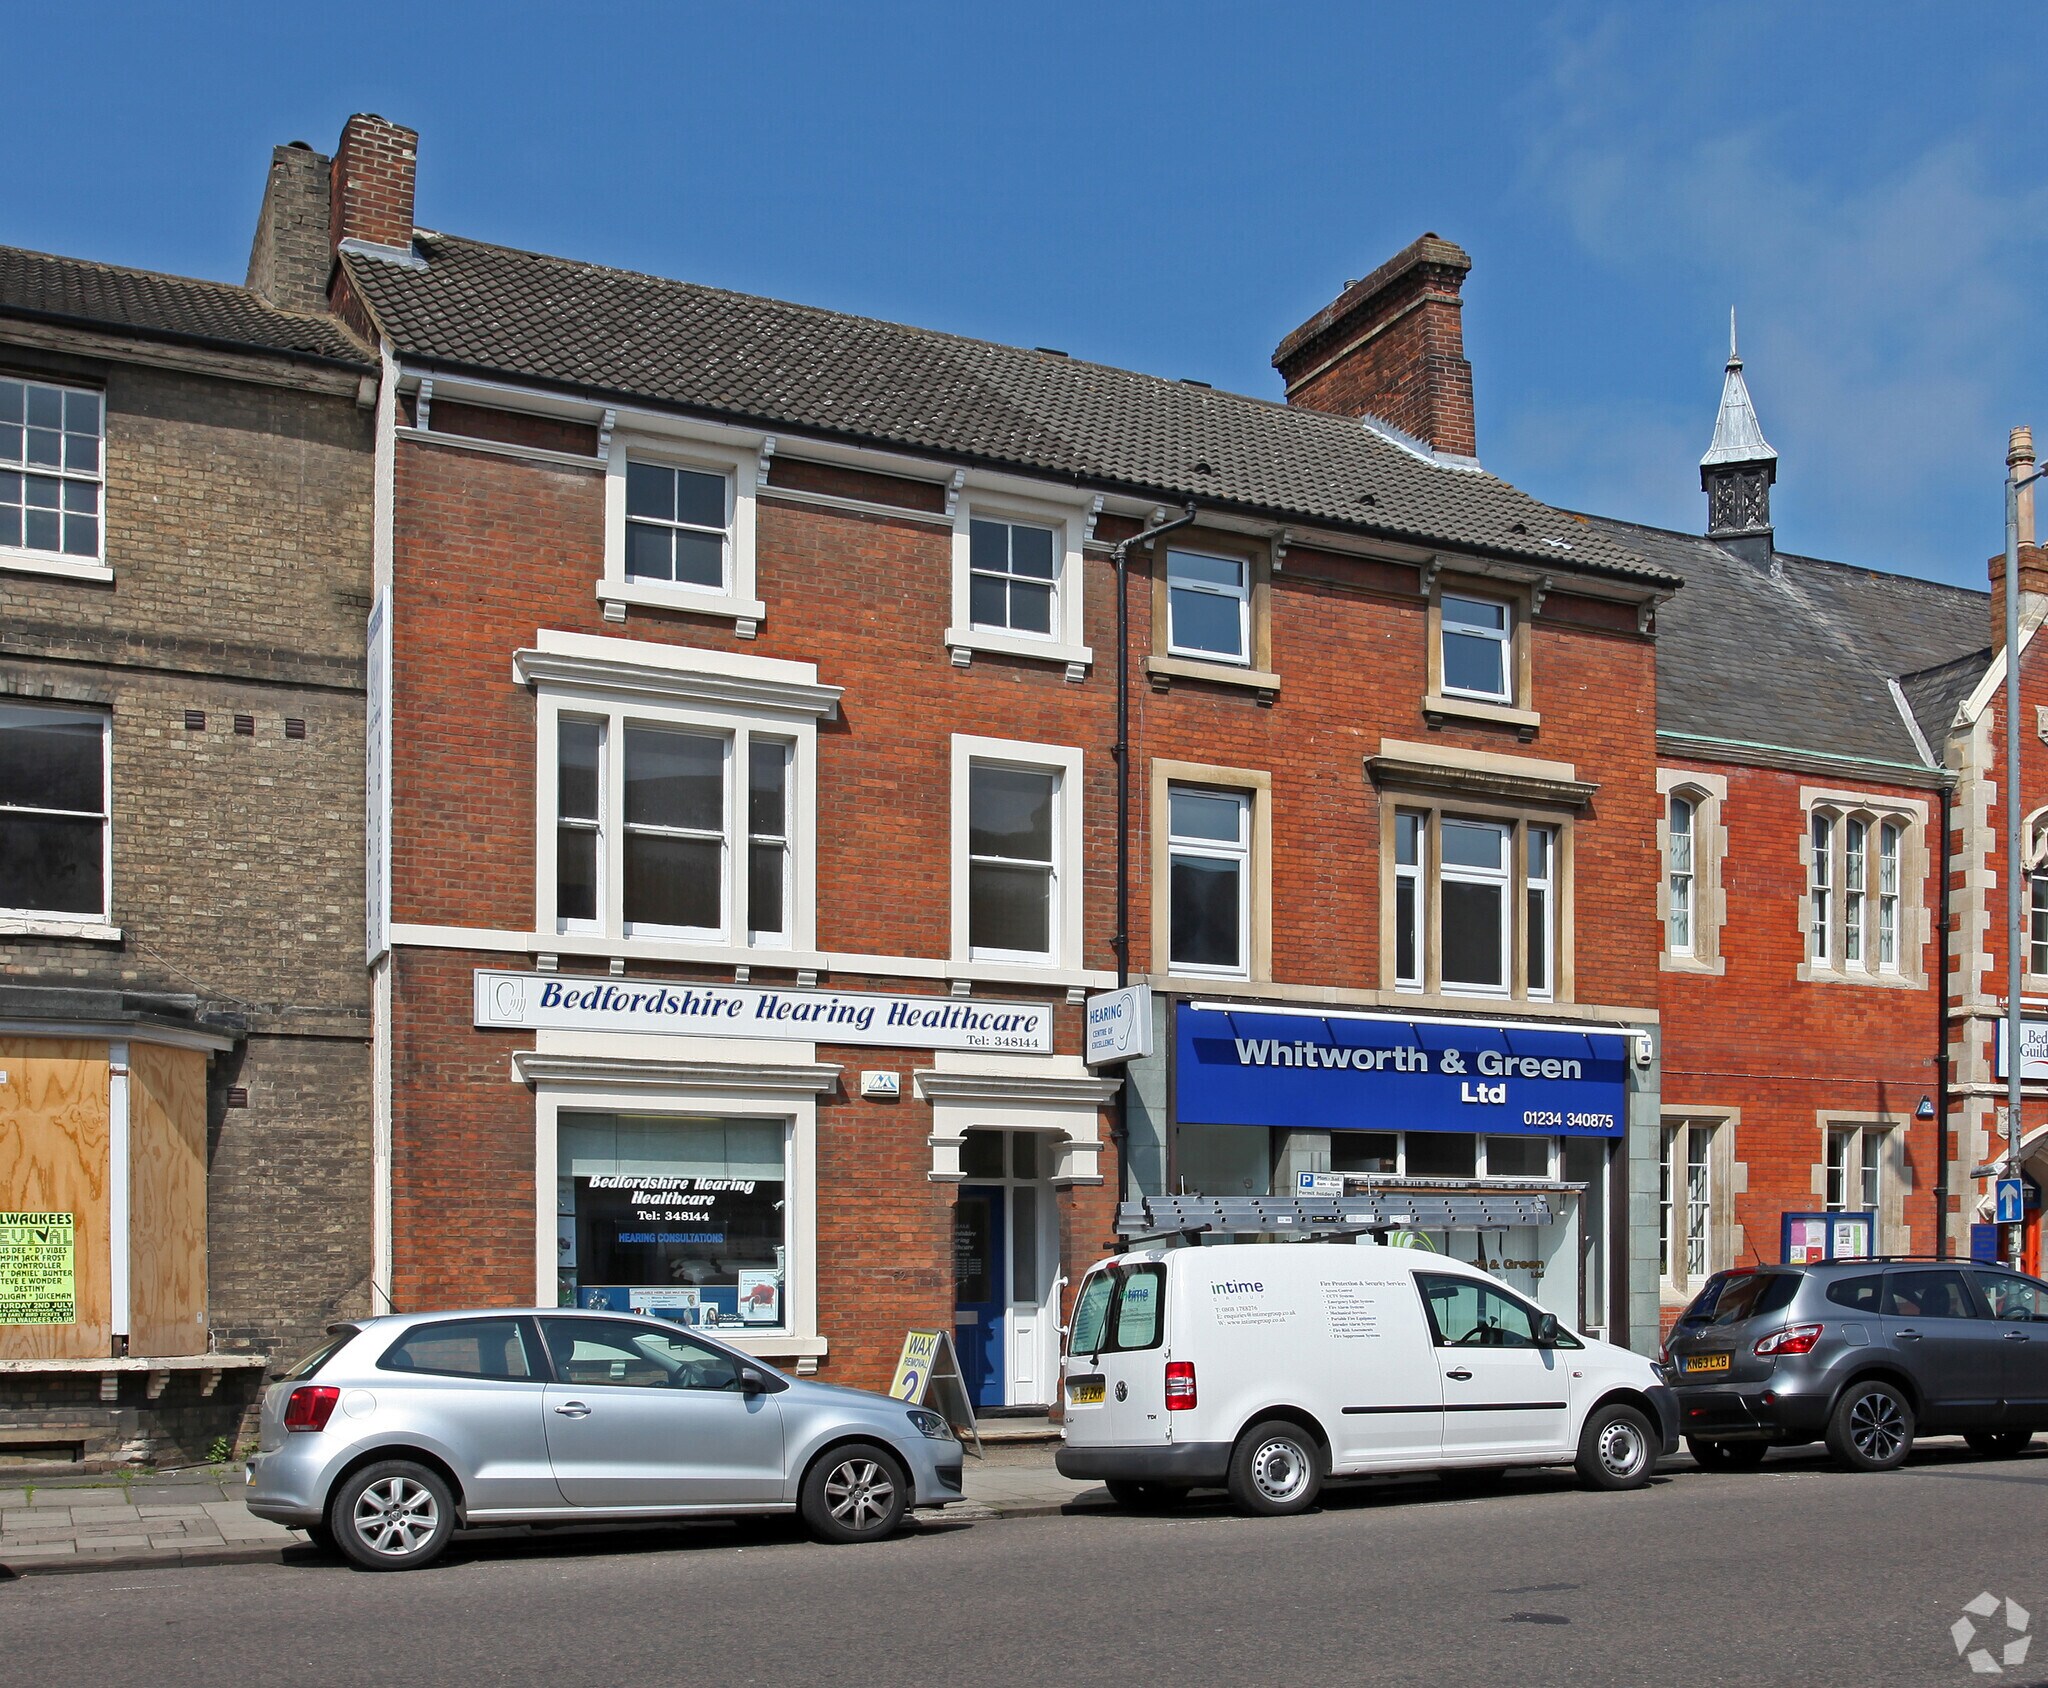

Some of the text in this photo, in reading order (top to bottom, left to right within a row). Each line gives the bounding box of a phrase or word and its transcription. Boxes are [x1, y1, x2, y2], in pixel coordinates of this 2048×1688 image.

[540, 982, 1039, 1033] Bedfordshire Hearing Healthcare
[1090, 1004, 1122, 1024] HEARING
[1093, 1027, 1113, 1038] CENTRE OF
[966, 1035, 1039, 1048] Tel: 348144
[1092, 1038, 1114, 1049] EXCELLENCE
[1235, 1038, 1582, 1079] Whitworth & Green
[1461, 1082, 1506, 1104] Ltd
[1523, 1111, 1613, 1129] 01234 340875
[589, 1175, 755, 1194] Bedfordshire Hearing
[631, 1191, 715, 1206] Healthcare
[637, 1211, 709, 1221] Tel: 348144
[618, 1233, 724, 1244] HEARING CONSULTATIONS
[35, 1247, 43, 1255] DJ
[1504, 1259, 1544, 1269] Green
[1210, 1280, 1264, 1294] intime
[908, 1336, 934, 1356] WAX
[903, 1357, 927, 1369] REMOVAL
[1687, 1356, 1727, 1370] KN63 LXB
